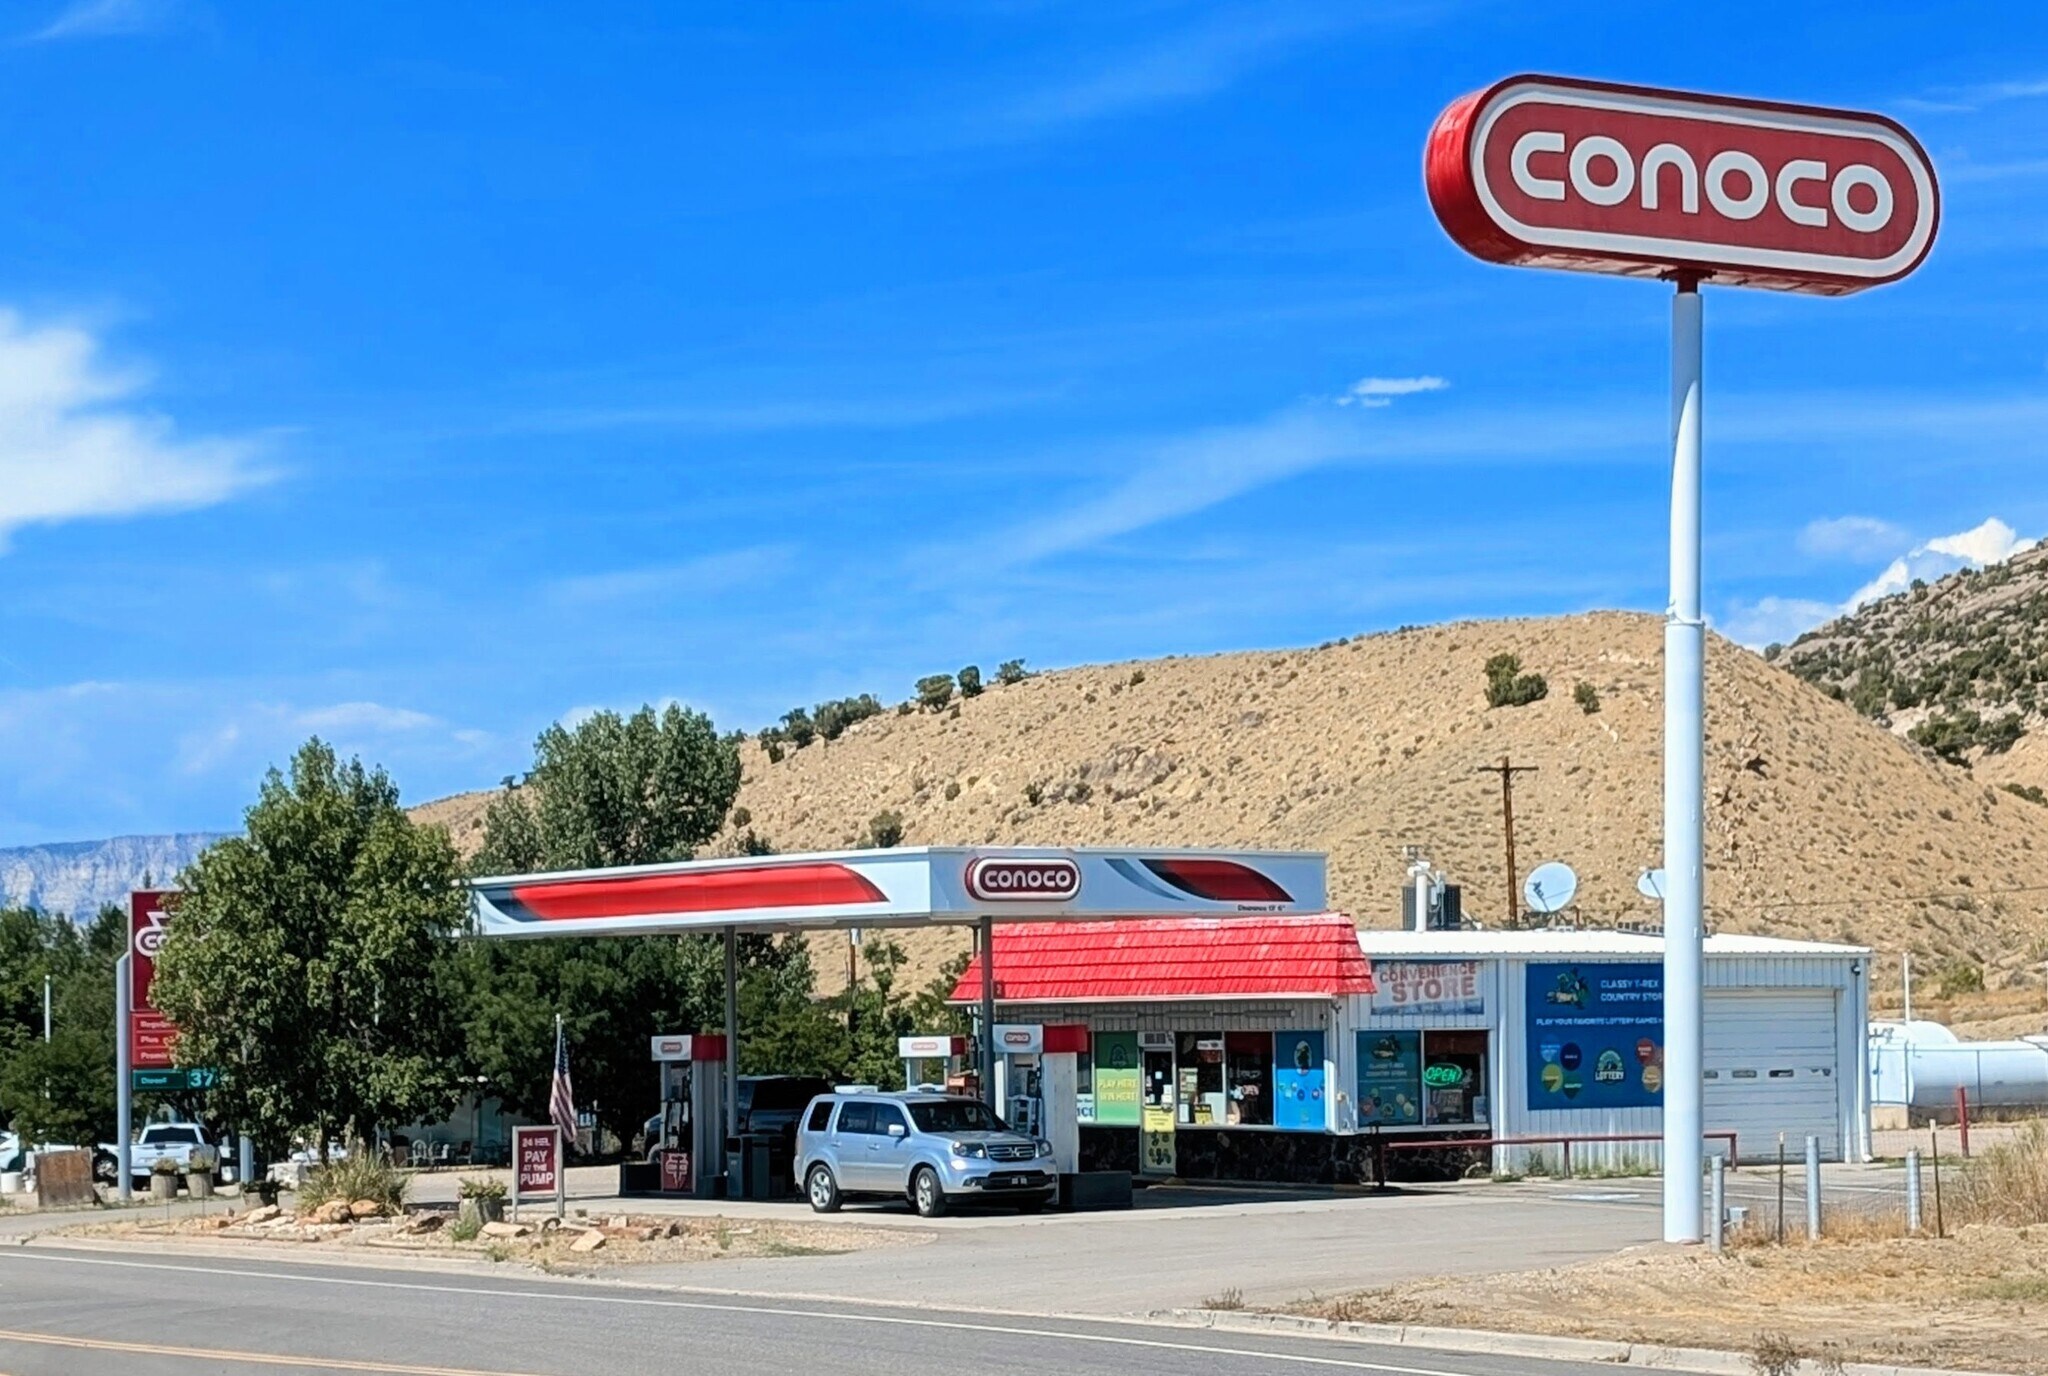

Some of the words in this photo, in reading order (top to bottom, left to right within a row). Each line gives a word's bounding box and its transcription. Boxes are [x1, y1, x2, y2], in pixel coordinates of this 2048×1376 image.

[1380, 961, 1476, 983] CONVENIENCE
[1392, 976, 1475, 1003] STORE
[1601, 980, 1632, 989] CLASSY
[1635, 980, 1659, 988] T-REX
[1600, 993, 1640, 1001] COUNTRY
[1642, 992, 1663, 1001] STOR
[1425, 1067, 1457, 1082] OPEN
[1595, 1071, 1624, 1081] LOTTERY
[522, 1137, 533, 1147] 24
[524, 1150, 548, 1162] PAY
[523, 1163, 532, 1171] AT
[533, 1163, 547, 1171] THE
[520, 1172, 554, 1186] PUMP
